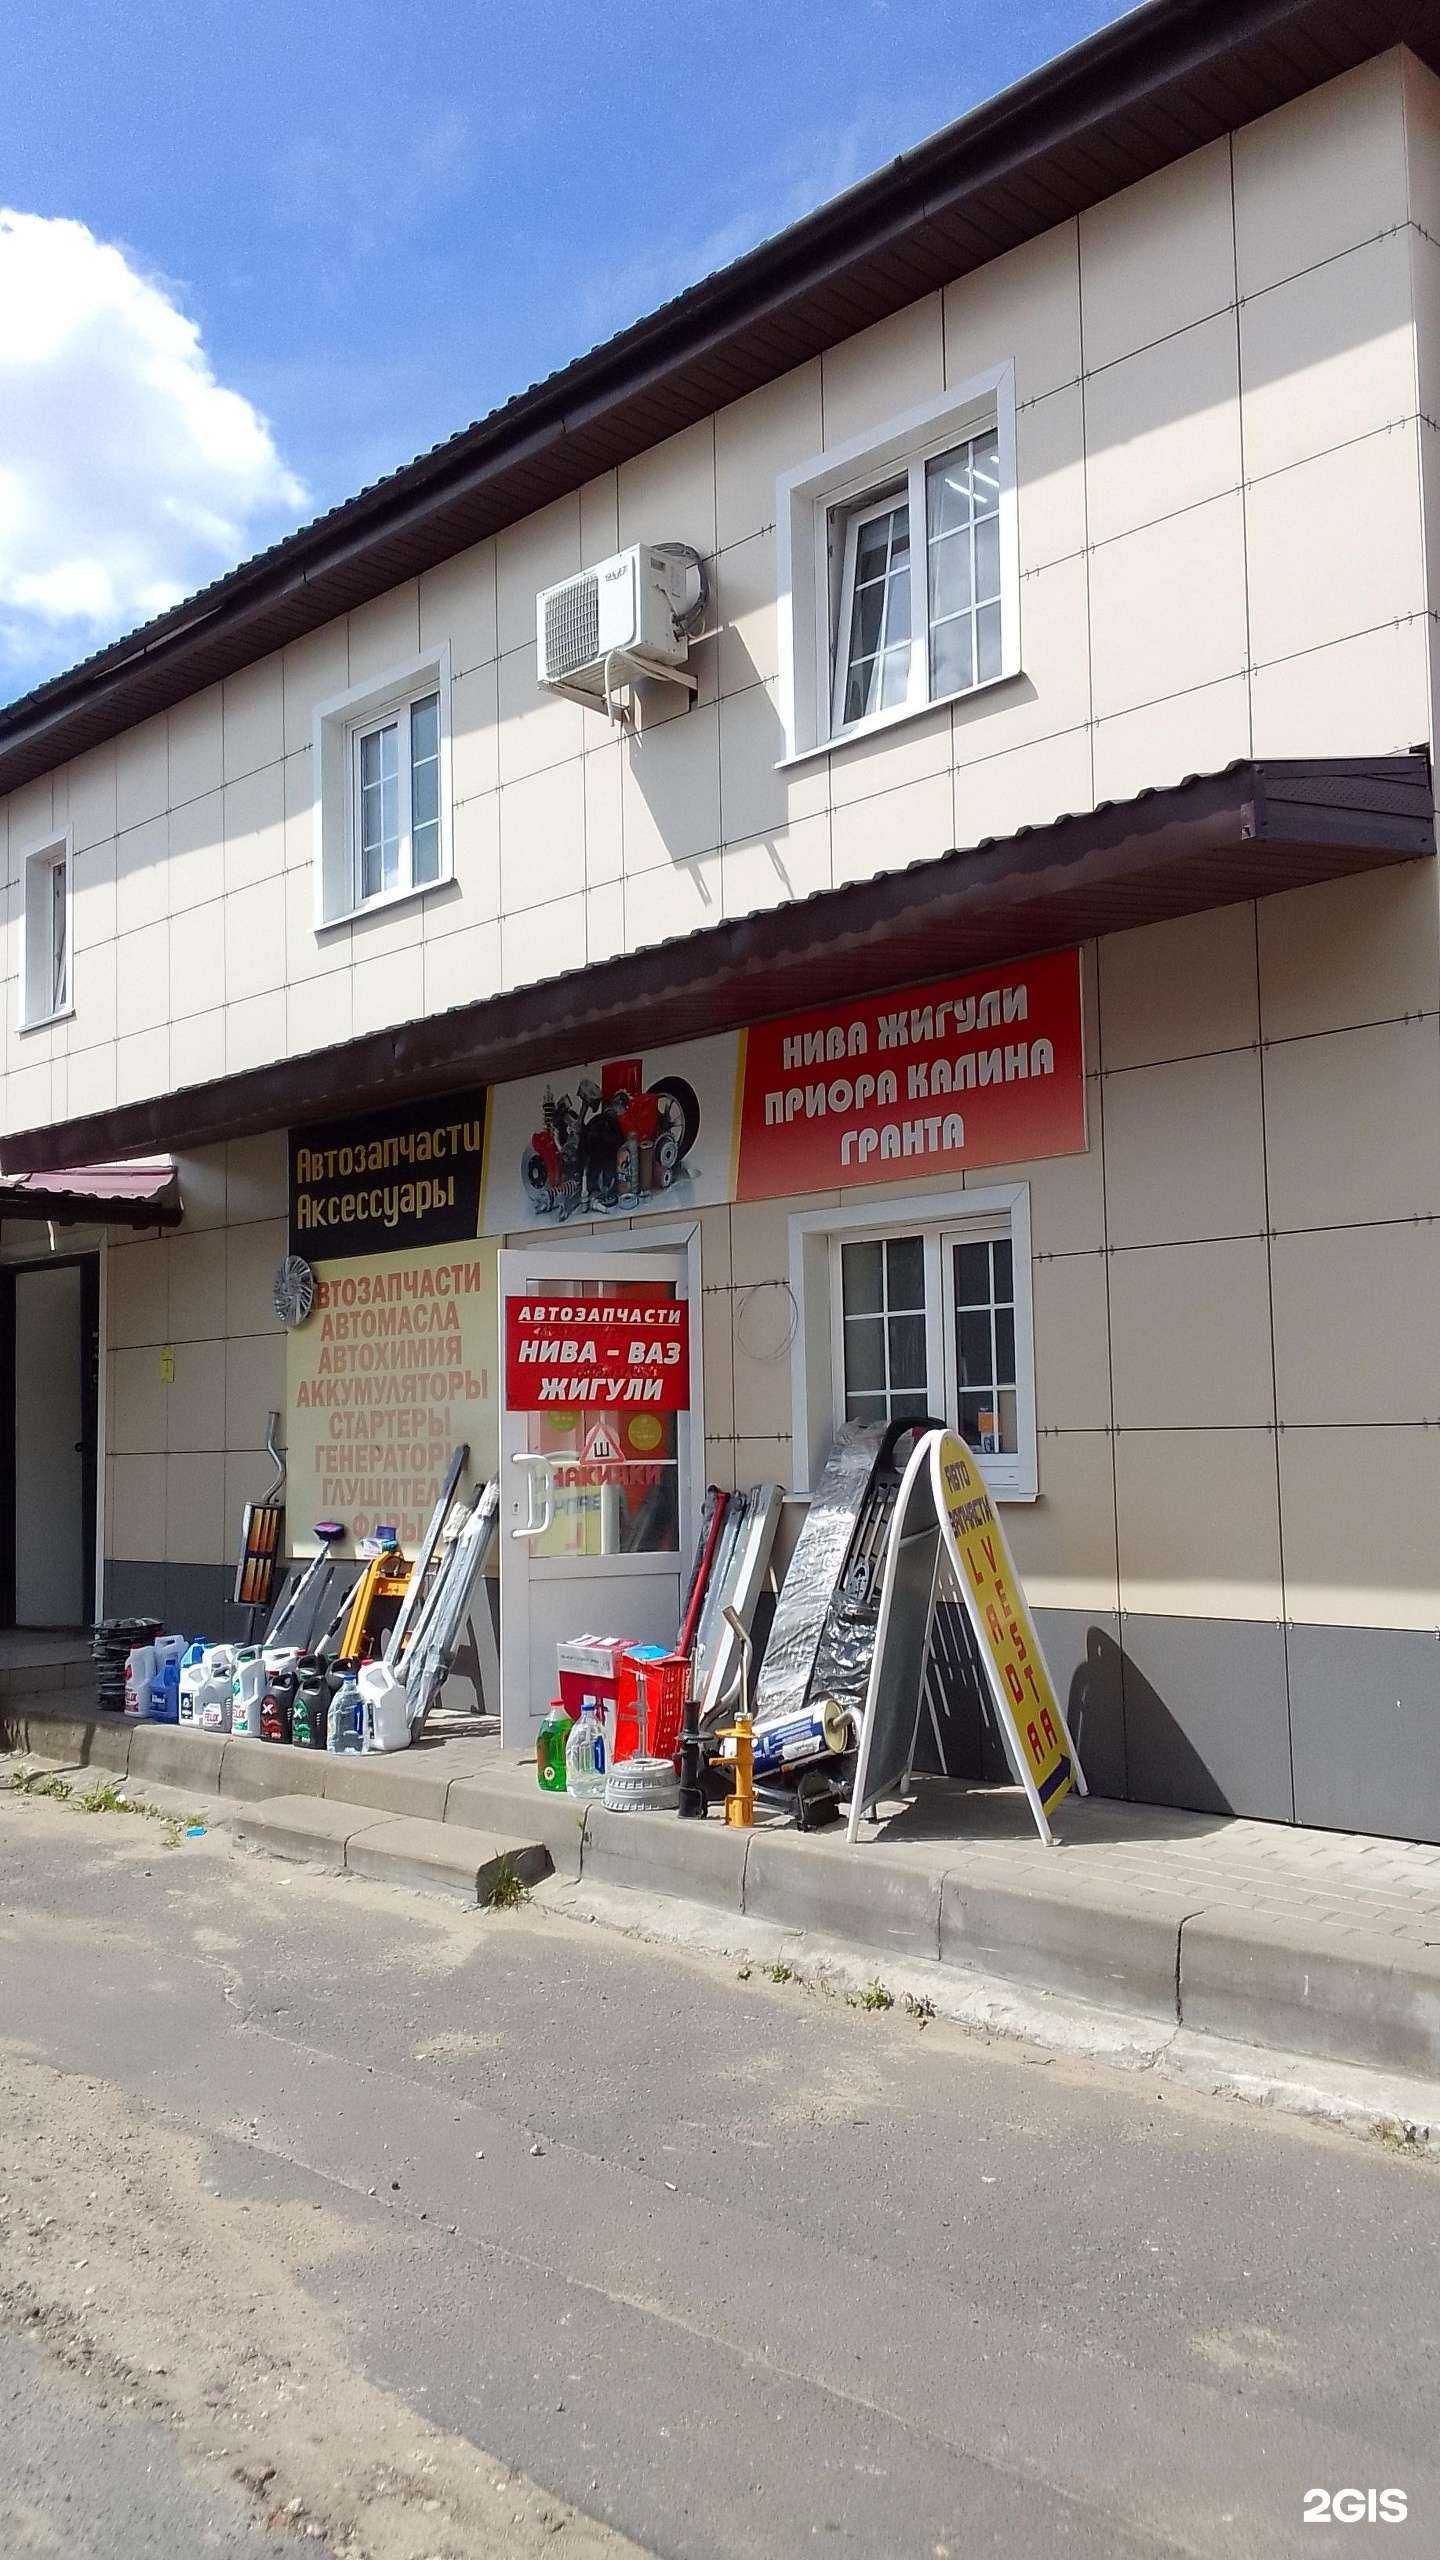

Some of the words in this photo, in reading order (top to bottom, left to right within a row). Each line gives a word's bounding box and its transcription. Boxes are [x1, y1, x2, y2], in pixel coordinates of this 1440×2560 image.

[783, 1021, 868, 1071] НИВА
[877, 983, 1028, 1051] ЖИГУЛИ
[764, 1069, 898, 1126] ПРИОРА
[907, 1037, 1054, 1100] КАЛИНА
[297, 1120, 481, 1184] Автозапчасти
[841, 1112, 965, 1166] ГРАНТА
[297, 1175, 455, 1230] Аксессуары
[316, 1262, 482, 1309] ВТОЗАПЧАСТИ
[320, 1301, 461, 1342] АВТОМАСЛА
[518, 1306, 681, 1324] АВТОЗАПЧАСТИ
[318, 1335, 463, 1375] АВТОХИМИЯ
[518, 1340, 597, 1364] НИВА
[627, 1341, 681, 1365] ВАЗ
[296, 1368, 489, 1408] АККУМУЛЯТОРЫ
[537, 1377, 664, 1401] ЖИГУЛИ
[329, 1407, 451, 1440] СТАРТЕРЫ
[322, 1478, 447, 1507] ГЛУШИТЕЛ
